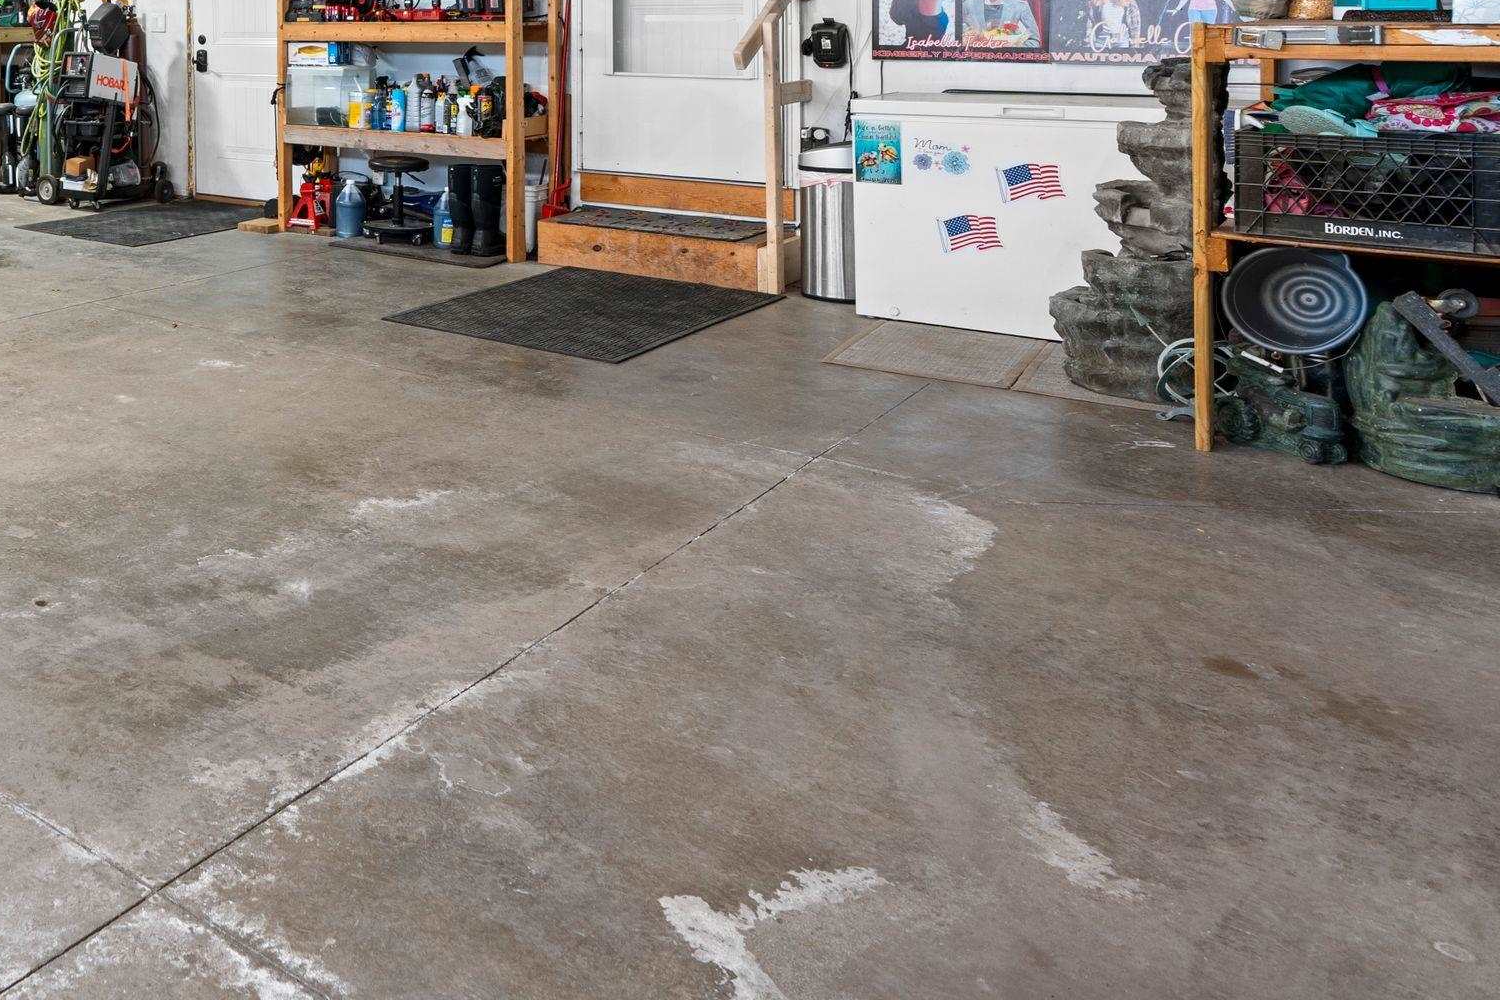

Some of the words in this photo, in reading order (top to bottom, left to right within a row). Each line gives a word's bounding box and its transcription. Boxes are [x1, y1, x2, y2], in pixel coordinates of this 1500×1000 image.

[906, 34, 961, 50] Isabella
[963, 34, 1011, 51] Tucker
[1174, 22, 1193, 54] G
[1050, 52, 1159, 63] WAUTOMA
[96, 74, 125, 91] HOBAR
[914, 137, 951, 151] Mom
